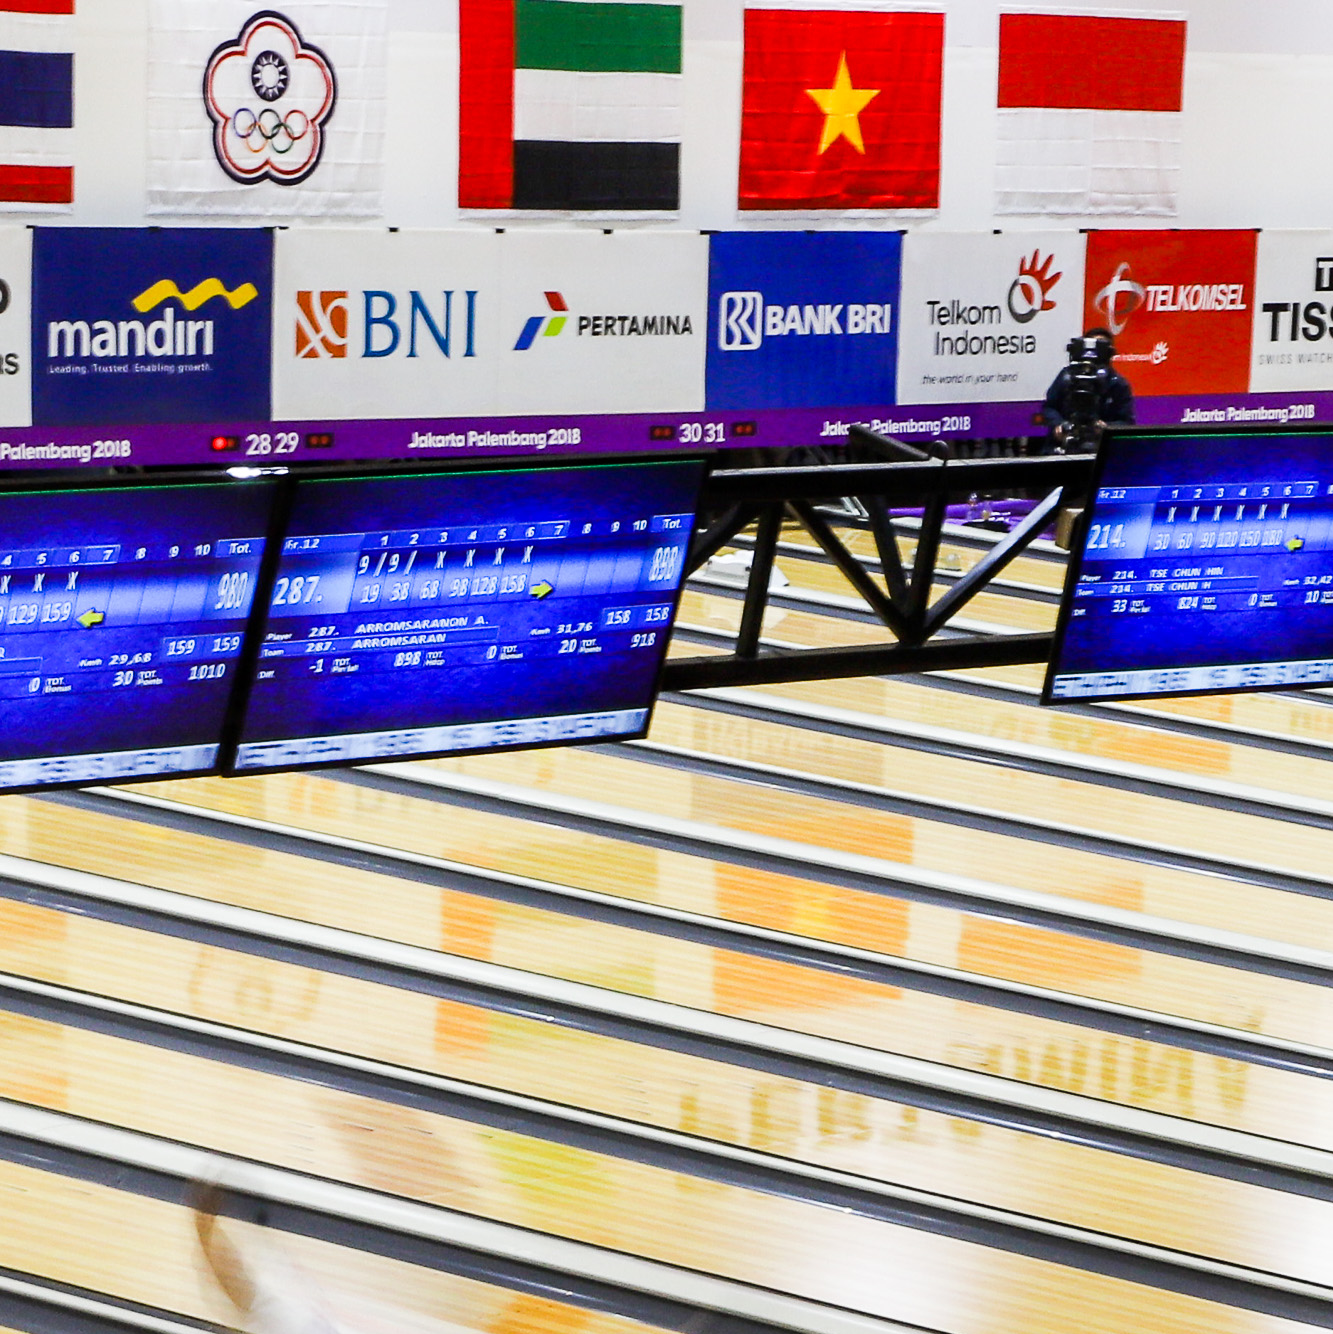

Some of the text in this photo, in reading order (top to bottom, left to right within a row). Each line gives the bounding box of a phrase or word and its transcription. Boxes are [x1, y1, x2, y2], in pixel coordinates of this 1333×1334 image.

[1146, 283, 1246, 312] TELKOMSEL
[361, 290, 479, 358] BNI
[764, 303, 890, 337] BANK BRI
[926, 300, 1001, 326] Telkom
[48, 307, 214, 357] mandiri
[577, 315, 693, 337] PERTAMINA
[934, 330, 1036, 356] Indonesia
[135, 363, 175, 375] Enabling
[942, 416, 971, 431] 2018
[1181, 404, 1315, 424] Jakarta Palembang 2018
[407, 428, 581, 449] Jakarta Palembang 2018
[679, 422, 726, 443] 30 31
[0, 432, 299, 462] Palembang 2018 28 29
[381, 534, 389, 546] 1
[409, 533, 419, 545] 2
[438, 531, 448, 543] 3
[467, 530, 478, 541] 4
[497, 528, 507, 539] 5
[526, 526, 536, 538] 6
[554, 524, 564, 536] 7
[582, 523, 592, 534] 8
[611, 521, 620, 533] 9
[633, 519, 648, 531] 10
[1086, 523, 1127, 550] 214.
[1, 542, 252, 566] 4 5 6 7 8 9 10 Tot.
[1151, 569, 1168, 578] TSE
[214, 572, 248, 610] 980
[271, 575, 323, 606] 287.
[360, 583, 380, 604] 19
[389, 581, 410, 602] 38
[419, 579, 440, 600] 68
[449, 578, 469, 598] 98
[470, 576, 498, 597] 128
[499, 574, 527, 594] 158
[7, 602, 72, 625] 129 159
[605, 607, 670, 625] 158 158
[308, 625, 340, 638] 287.
[354, 616, 469, 635] ARROMSARANON
[474, 615, 489, 625] A.
[556, 622, 593, 635] 31,76
[166, 636, 241, 656] 159 159
[262, 633, 447, 657] Team 287. ARROMSARAN
[393, 651, 422, 668] 898
[558, 639, 577, 654] 20
[630, 632, 656, 648] 918
[108, 652, 152, 667] 29,68
[113, 670, 134, 687] 30
[187, 663, 226, 681] 1010
